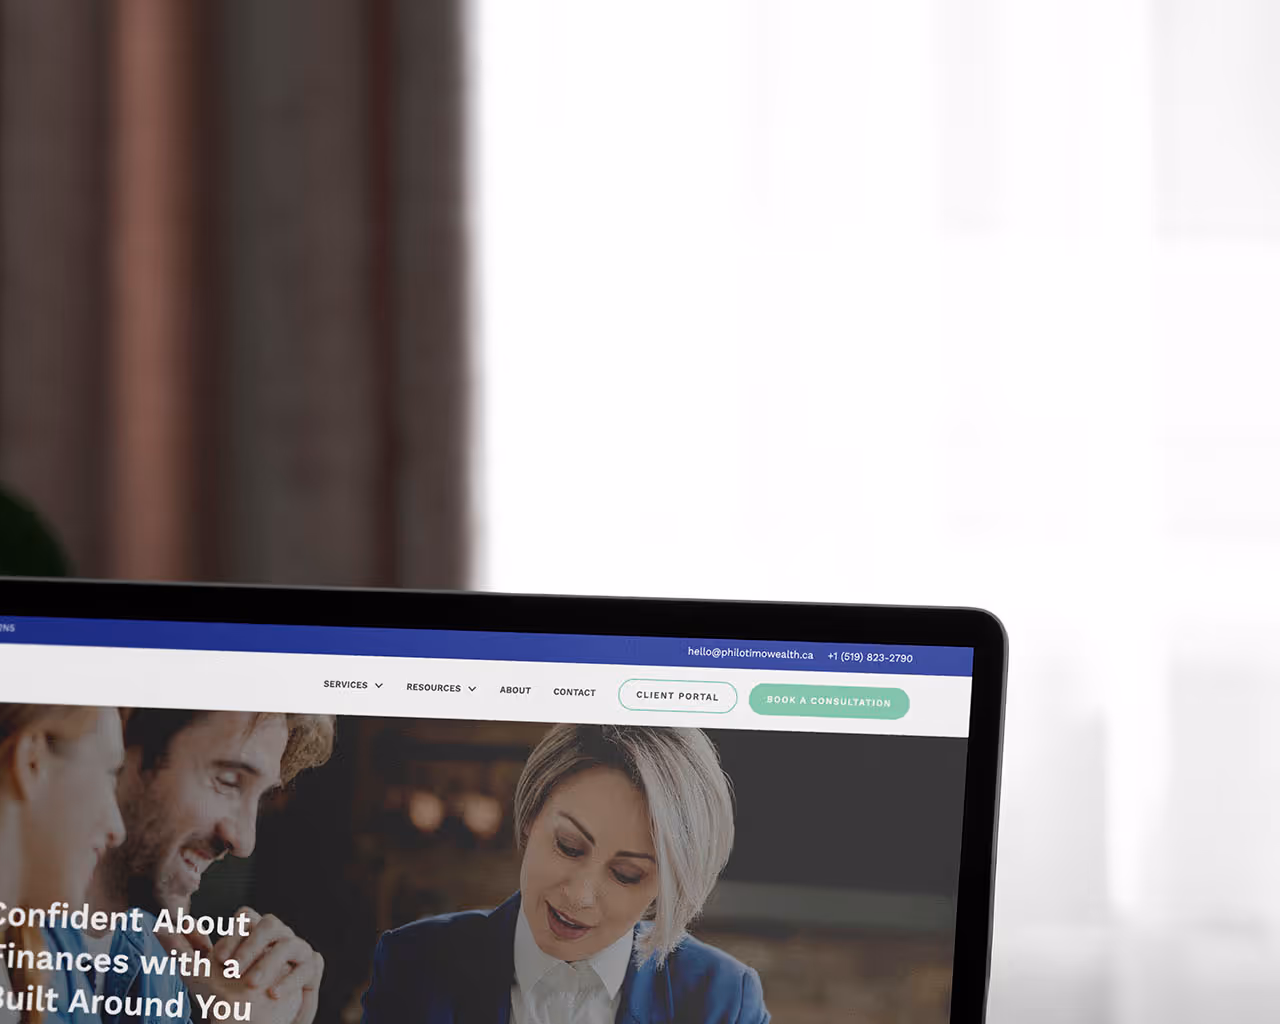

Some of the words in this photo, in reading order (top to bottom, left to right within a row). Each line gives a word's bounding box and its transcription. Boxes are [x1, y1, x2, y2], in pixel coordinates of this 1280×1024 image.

[688, 647, 814, 661] hello@philotimowealth.ca
[827, 652, 839, 661] +1
[840, 652, 864, 663] (519)
[866, 653, 914, 664] 823-2790
[323, 680, 368, 690] SERVICES
[406, 683, 461, 694] RESOURCES
[500, 686, 531, 695] ABOUT
[553, 688, 596, 697] CONTACT
[636, 690, 674, 700] CLIENT
[678, 692, 719, 702] PORTAL
[766, 694, 796, 704] BOOK
[800, 696, 808, 705] A
[810, 697, 891, 708] CONSULTATION
[152, 907, 250, 938] About
[140, 949, 211, 978] with
[222, 958, 241, 979] a
[67, 988, 184, 1019] Around
[195, 994, 252, 1022] You
